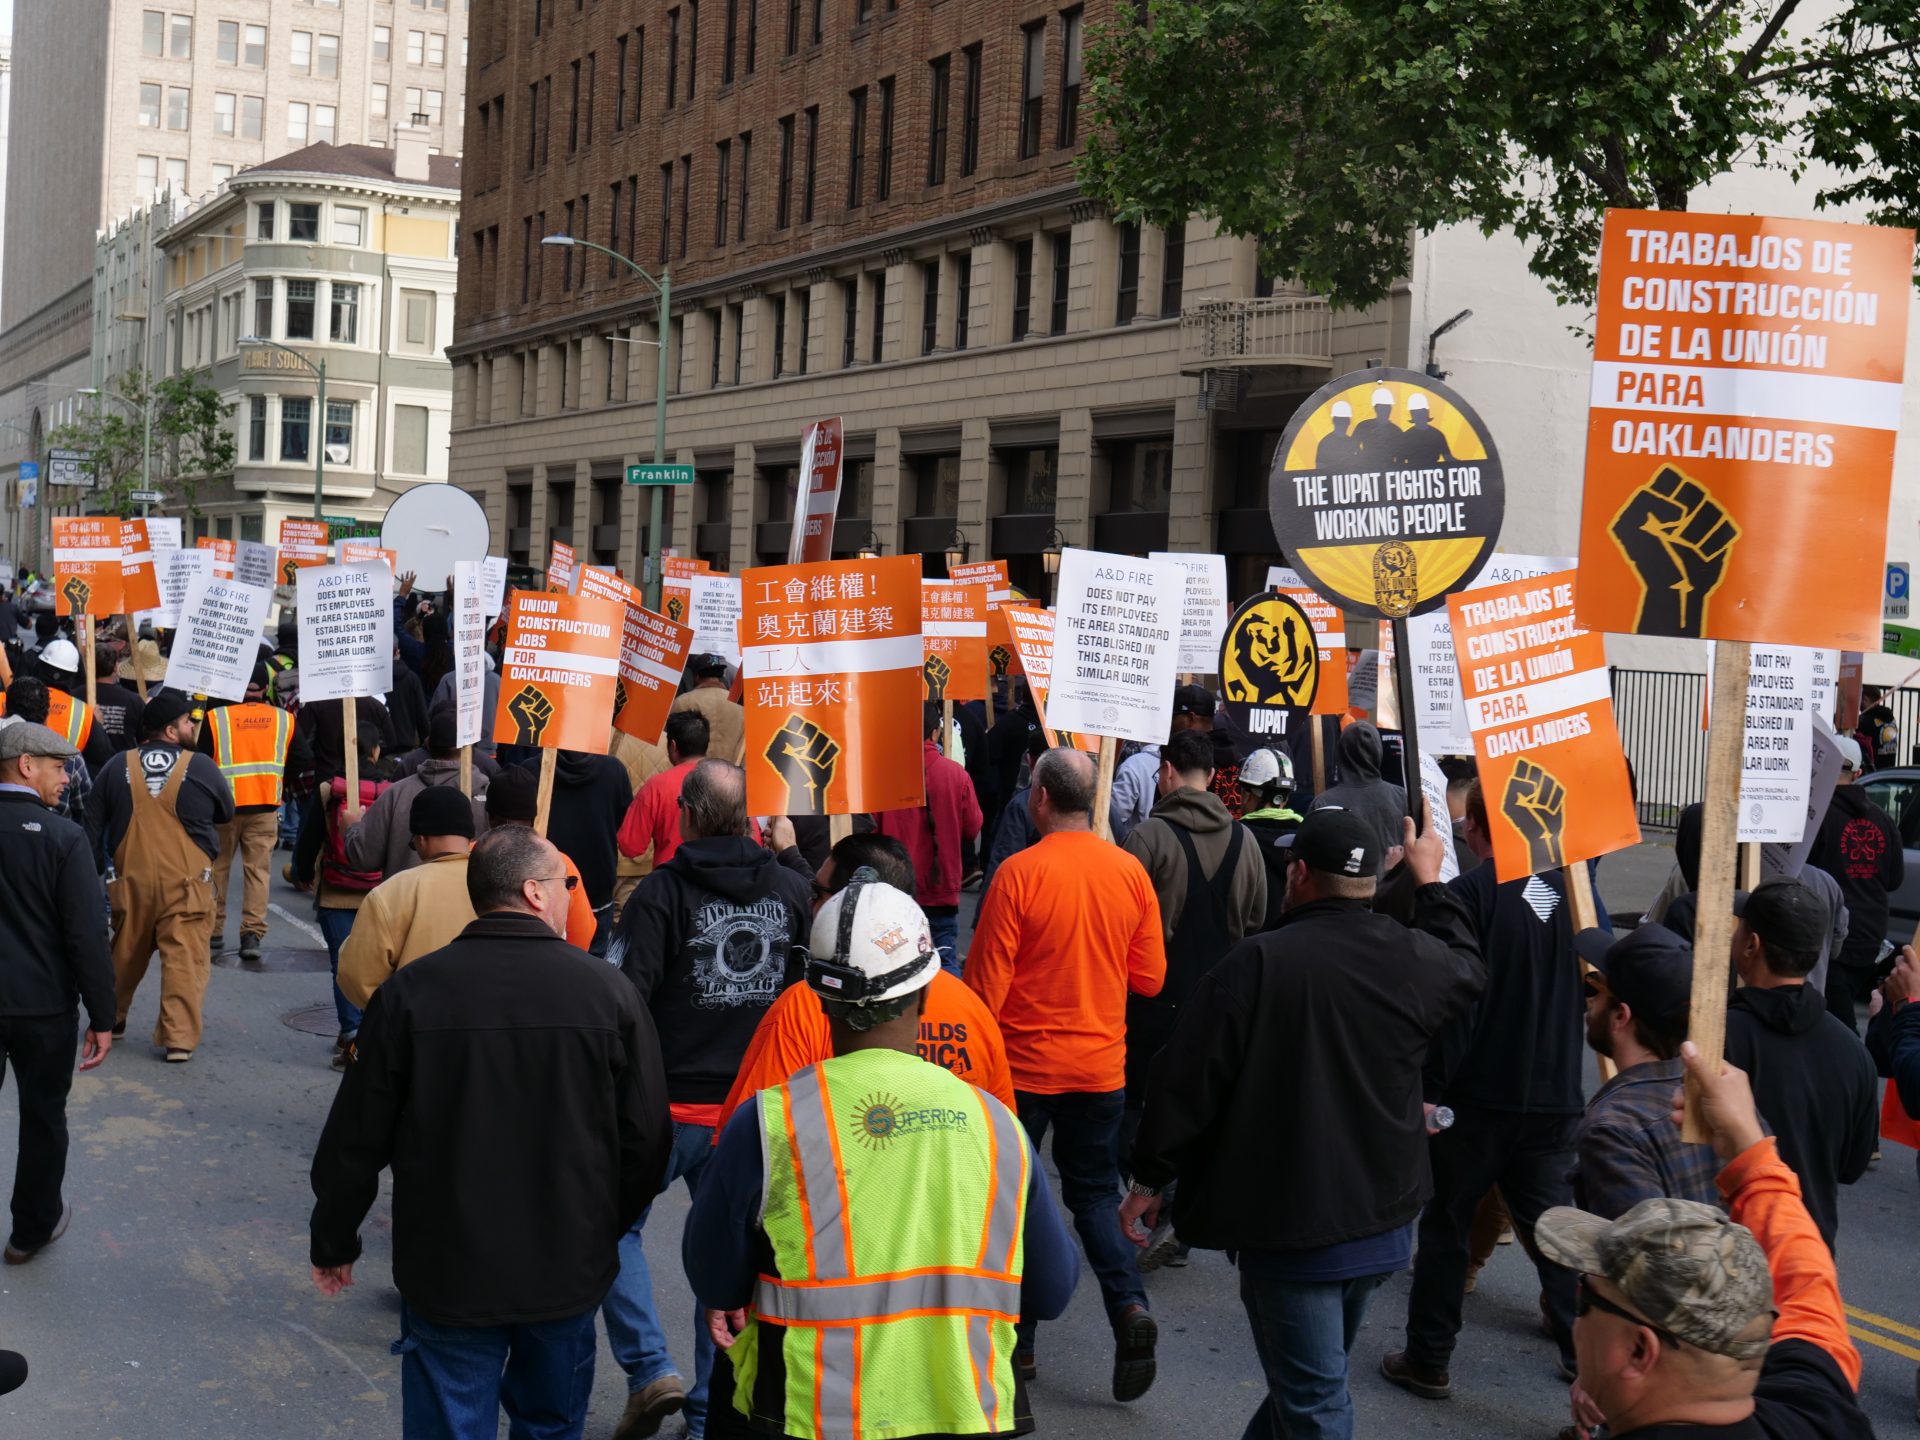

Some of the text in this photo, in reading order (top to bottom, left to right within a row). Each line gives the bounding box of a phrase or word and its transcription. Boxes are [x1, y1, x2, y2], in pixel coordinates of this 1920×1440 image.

[1626, 228, 1853, 276] TRABAJOS DE
[1621, 276, 1878, 326] CONSTRUCCIÓN
[1618, 323, 1828, 369] DE LA UNIÓN
[1616, 370, 1705, 408] PARA
[1611, 420, 1835, 469] OAKLANDERS
[632, 469, 688, 481] Franklin
[1293, 466, 1482, 506] THE IUPAT FIGHTS FOR
[1314, 502, 1466, 540] WORKING PEOPLE
[953, 565, 996, 577] TRABAJOS DE
[1095, 567, 1154, 586] A&D FIRE
[1191, 564, 1208, 573] FIRE
[1490, 568, 1523, 583] A&D
[318, 573, 369, 588] A&D FIRE
[584, 569, 632, 596] TRABAJOS DE
[710, 581, 731, 589] HELIX
[954, 573, 1002, 586] CONSTRUCCIÓN
[1890, 573, 1904, 595] P
[207, 586, 251, 603] A&D FIRE
[318, 587, 371, 600] DOES NOT PAY
[1087, 587, 1156, 607] DOES NOT PAY
[1187, 598, 1221, 606] STANDARD
[203, 598, 248, 614] DOES NOT PAY
[316, 598, 374, 612] ITS EMPLOYEES
[519, 598, 558, 614] UNION
[1082, 602, 1158, 623] ITS EMPLOYEES
[1460, 584, 1573, 627] TRABAJOS DE
[1891, 605, 1907, 615] HERE
[199, 608, 248, 625] ITS EMPLOYEES
[306, 609, 384, 625] THE AREA STANDARD
[625, 606, 678, 638] TRABAJOS DE
[756, 606, 893, 640] 奧克蘭建築
[1199, 619, 1211, 627] FOR
[188, 616, 254, 637] THE AREA STANDARD
[315, 622, 376, 636] ESTABLISHED IN
[517, 616, 611, 638] CONSTRUCTION
[1067, 616, 1169, 641] THE AREA STANDARD
[193, 628, 244, 645] ESTABLISHED IN
[317, 634, 374, 647] THIS AREA FOR
[514, 633, 547, 648] JOBS
[1078, 634, 1156, 655] ESTABLISHED IN
[1431, 641, 1452, 649] DOES
[191, 637, 239, 654] THIS AREA FOR
[317, 646, 376, 659] SIMILAR WORK
[627, 637, 665, 662] LA UNIÓN
[1020, 642, 1032, 654] DE
[188, 647, 238, 664] SIMILAR WORK
[513, 651, 536, 664] FOR
[757, 647, 811, 673] 工人
[1078, 650, 1149, 670] THIS AREA FOR
[1429, 653, 1441, 661] ITS
[1755, 654, 1791, 669] NOT PAY
[1026, 659, 1048, 672] PARA
[1418, 666, 1433, 674] THE
[1473, 645, 1574, 693] DE LA UNIÓN
[510, 667, 592, 687] OAKLANDERS
[1076, 666, 1149, 686] SIMILAR WORK
[1060, 694, 1100, 702] CONSTRUCTION
[1430, 690, 1449, 698] THIS
[1818, 690, 1824, 699] IN
[1479, 693, 1529, 724] PARA
[1760, 696, 1803, 710] STANDARD
[1249, 708, 1289, 735] IUPAT
[1784, 718, 1794, 730] IN
[1485, 711, 1591, 758] OAKLANDERS
[1748, 736, 1789, 750] AREA FOR
[149, 754, 166, 766] UA
[1764, 757, 1790, 771] WORK
[702, 902, 784, 928] INSULATORS
[866, 1108, 967, 1134] SUPERIOR
